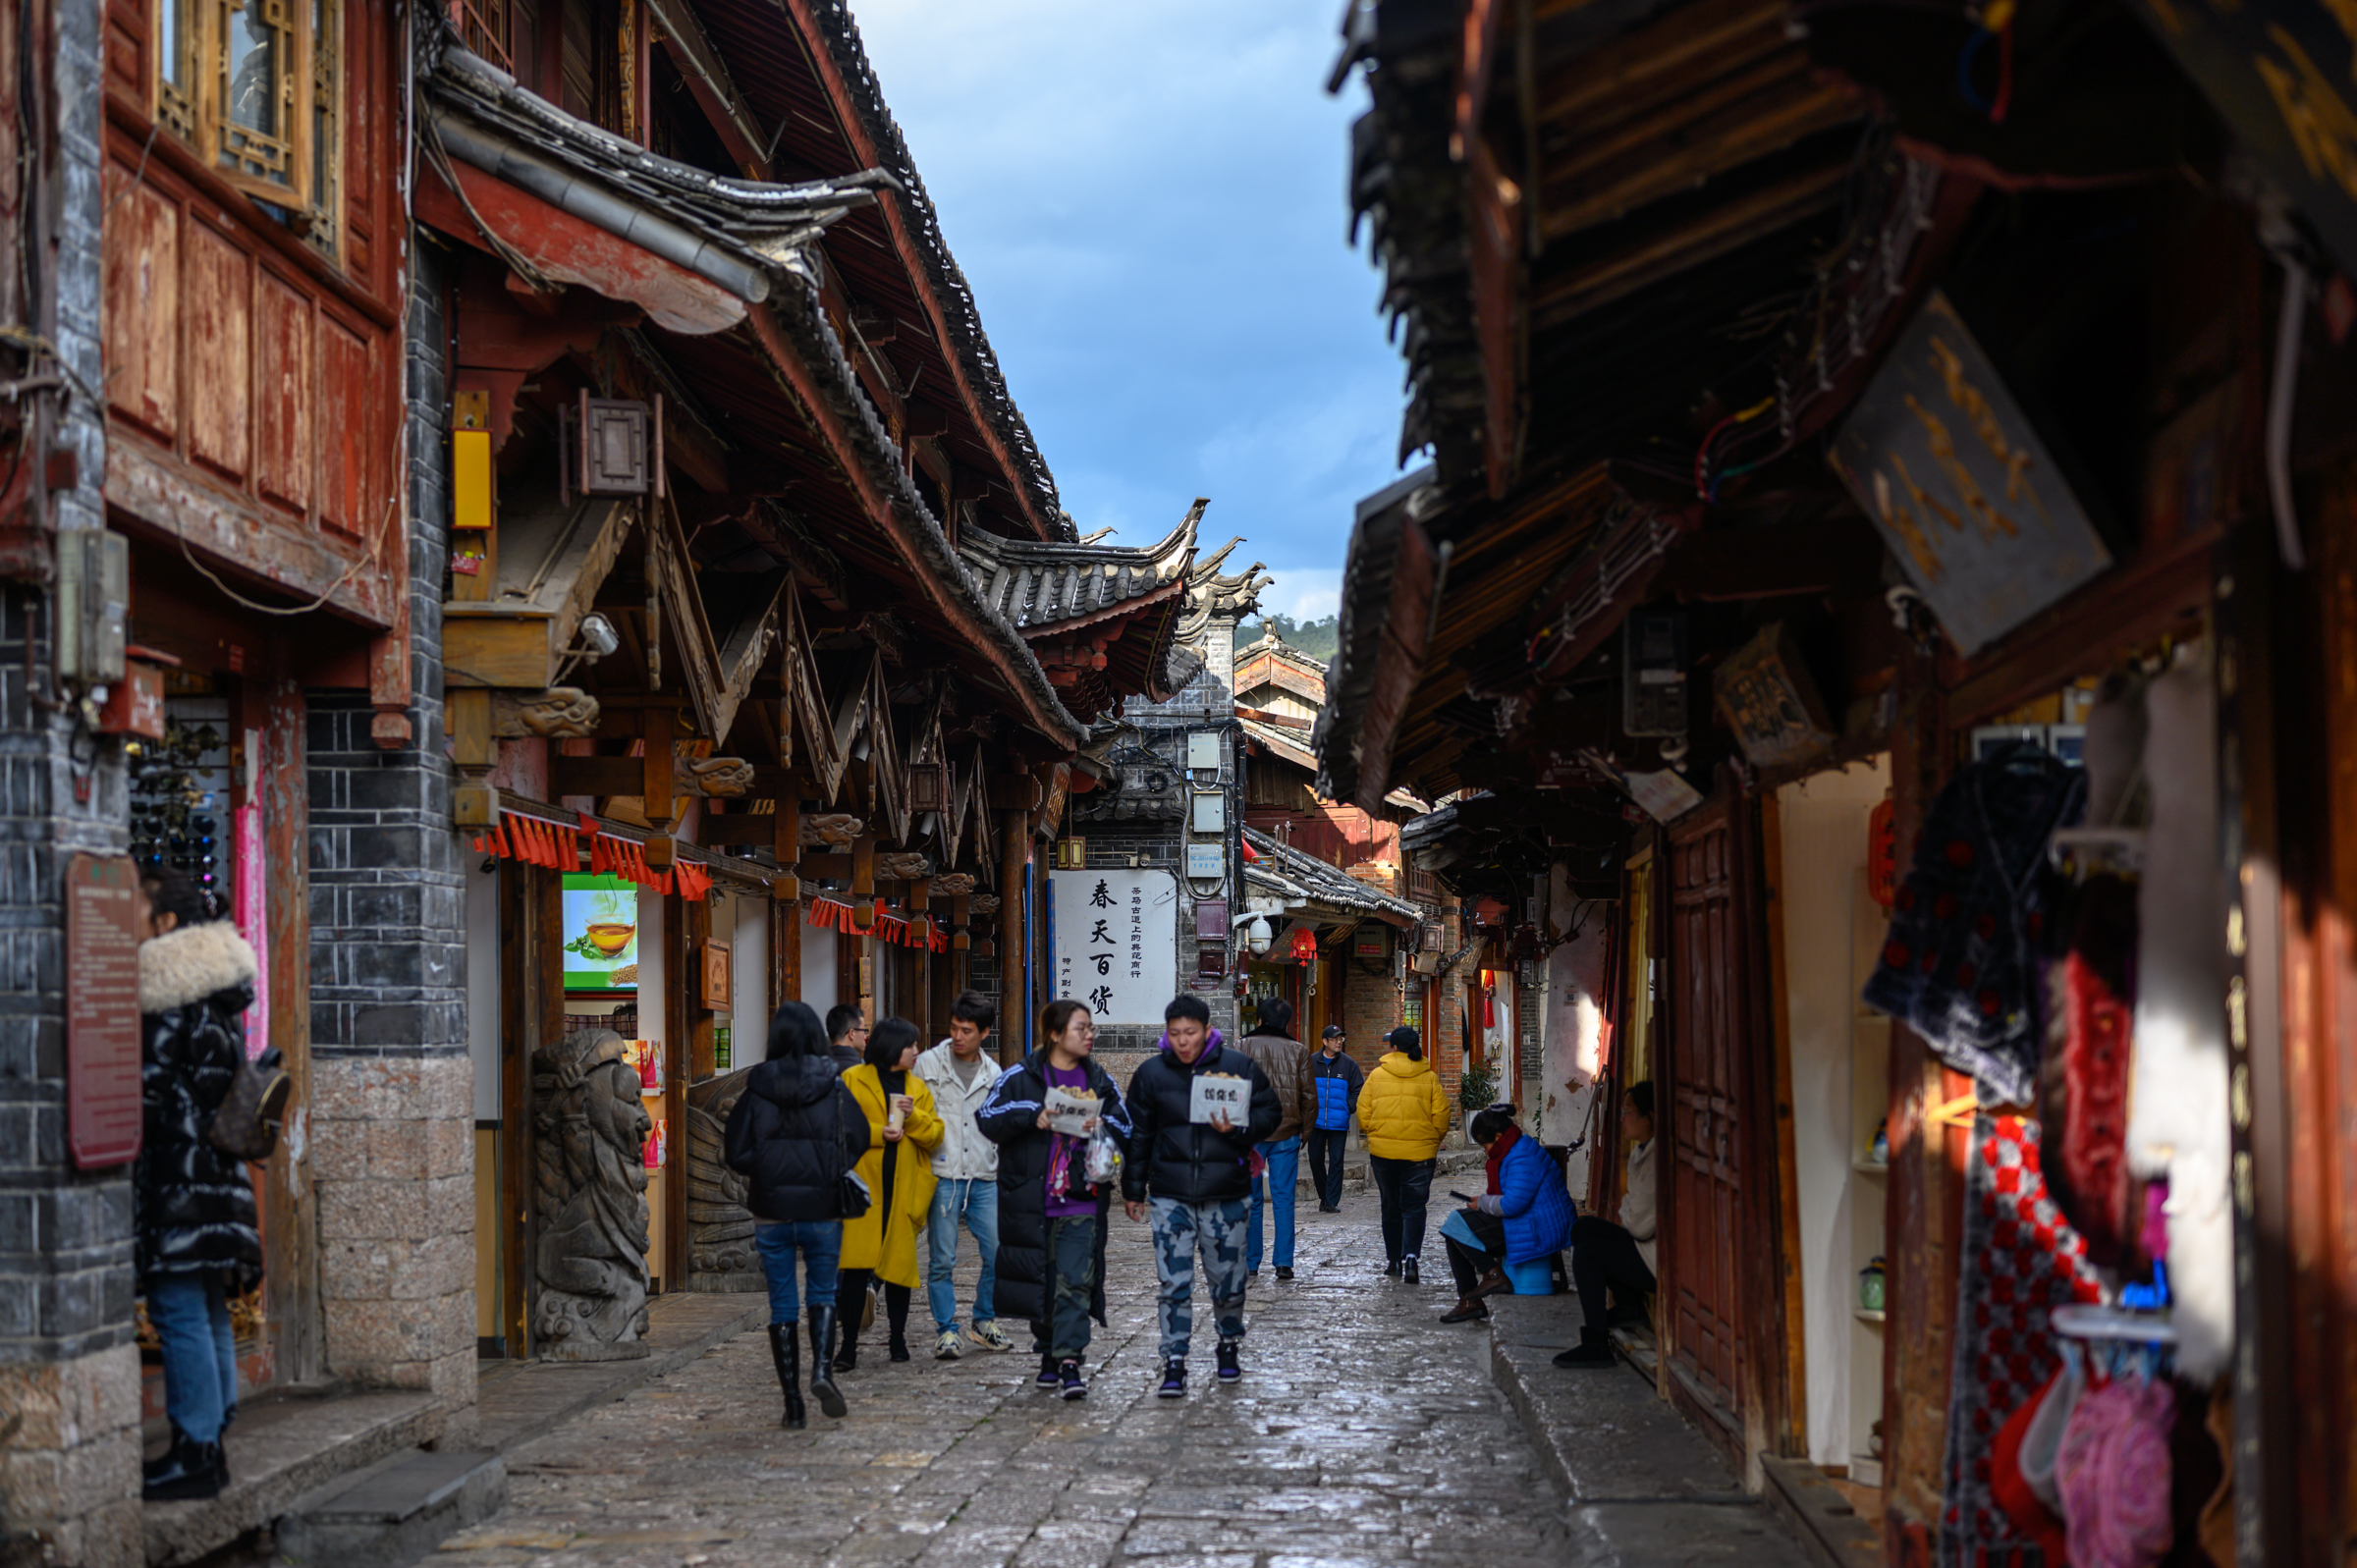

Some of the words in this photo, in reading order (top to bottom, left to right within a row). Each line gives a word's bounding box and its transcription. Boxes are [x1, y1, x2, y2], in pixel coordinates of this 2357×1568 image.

[1061, 957, 1072, 999] 特产副食
[1088, 878, 1118, 1016] 春天百货
[1130, 887, 1142, 979] 茶马古道上的典范商行
